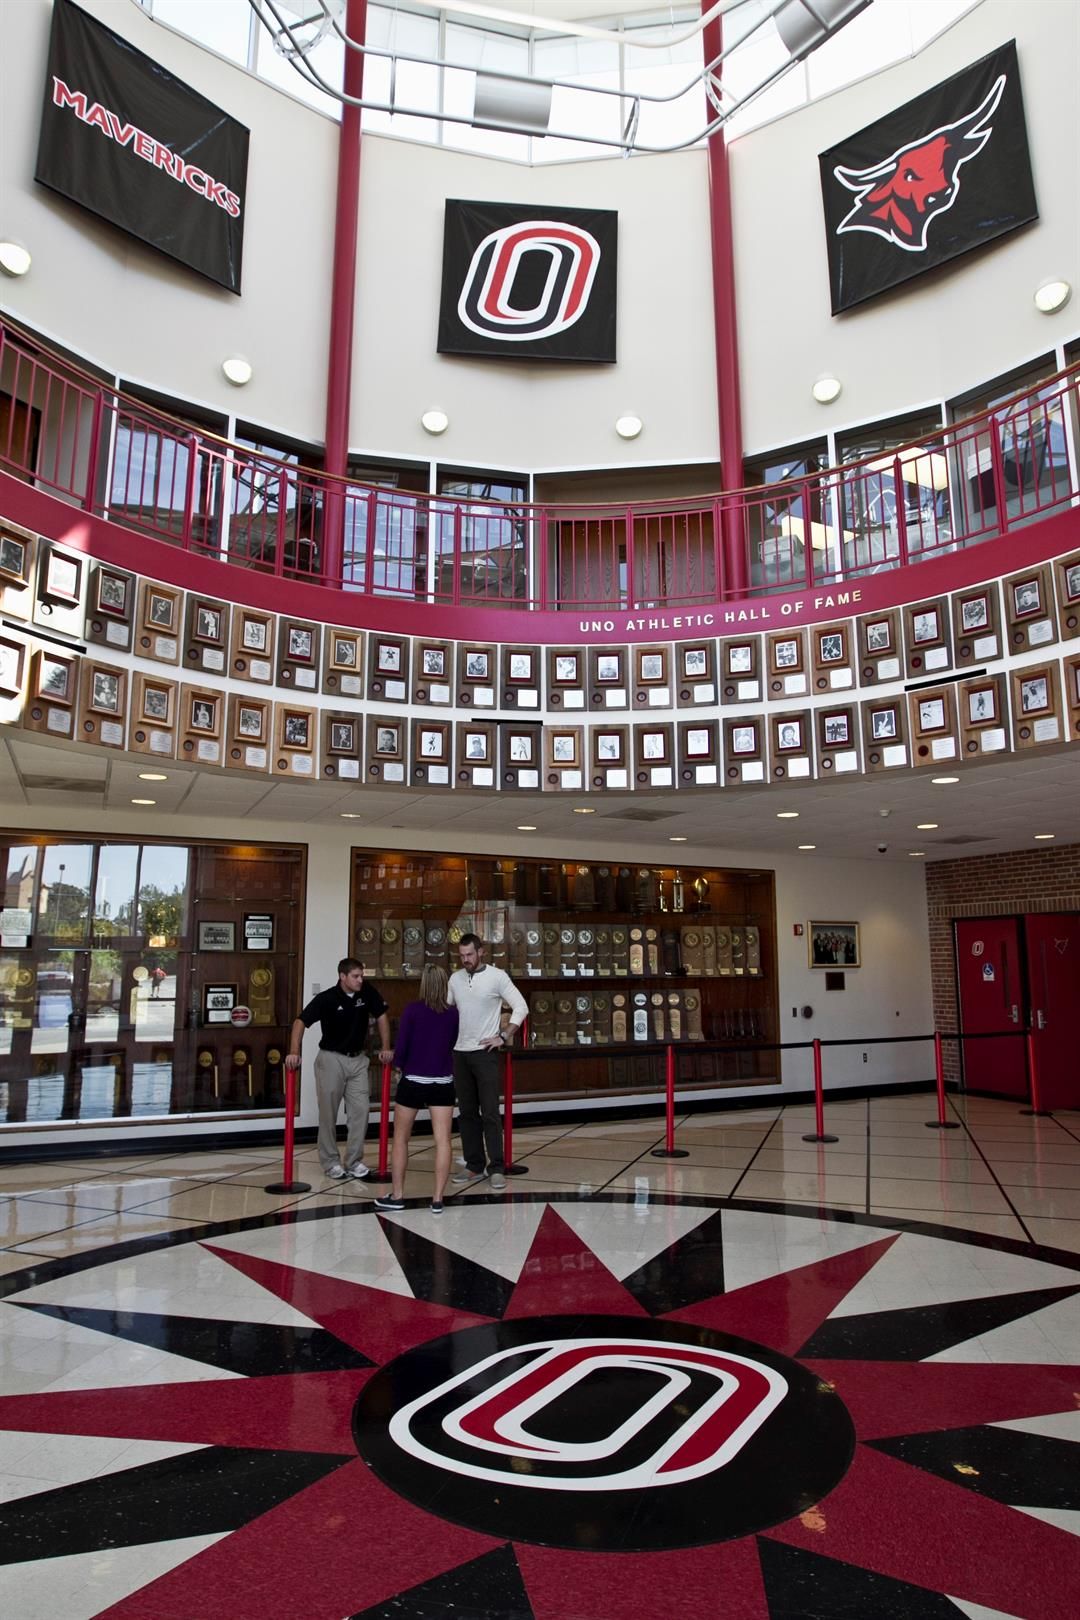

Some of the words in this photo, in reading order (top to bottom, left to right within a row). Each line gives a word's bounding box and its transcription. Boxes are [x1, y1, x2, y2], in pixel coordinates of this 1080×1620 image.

[53, 76, 240, 217] MAVERICKS
[457, 220, 601, 341] O
[579, 620, 615, 632] UNO
[625, 613, 715, 631] ATHLETIC
[724, 607, 771, 623] HALL
[780, 600, 804, 616] OF
[814, 589, 863, 610] FAME
